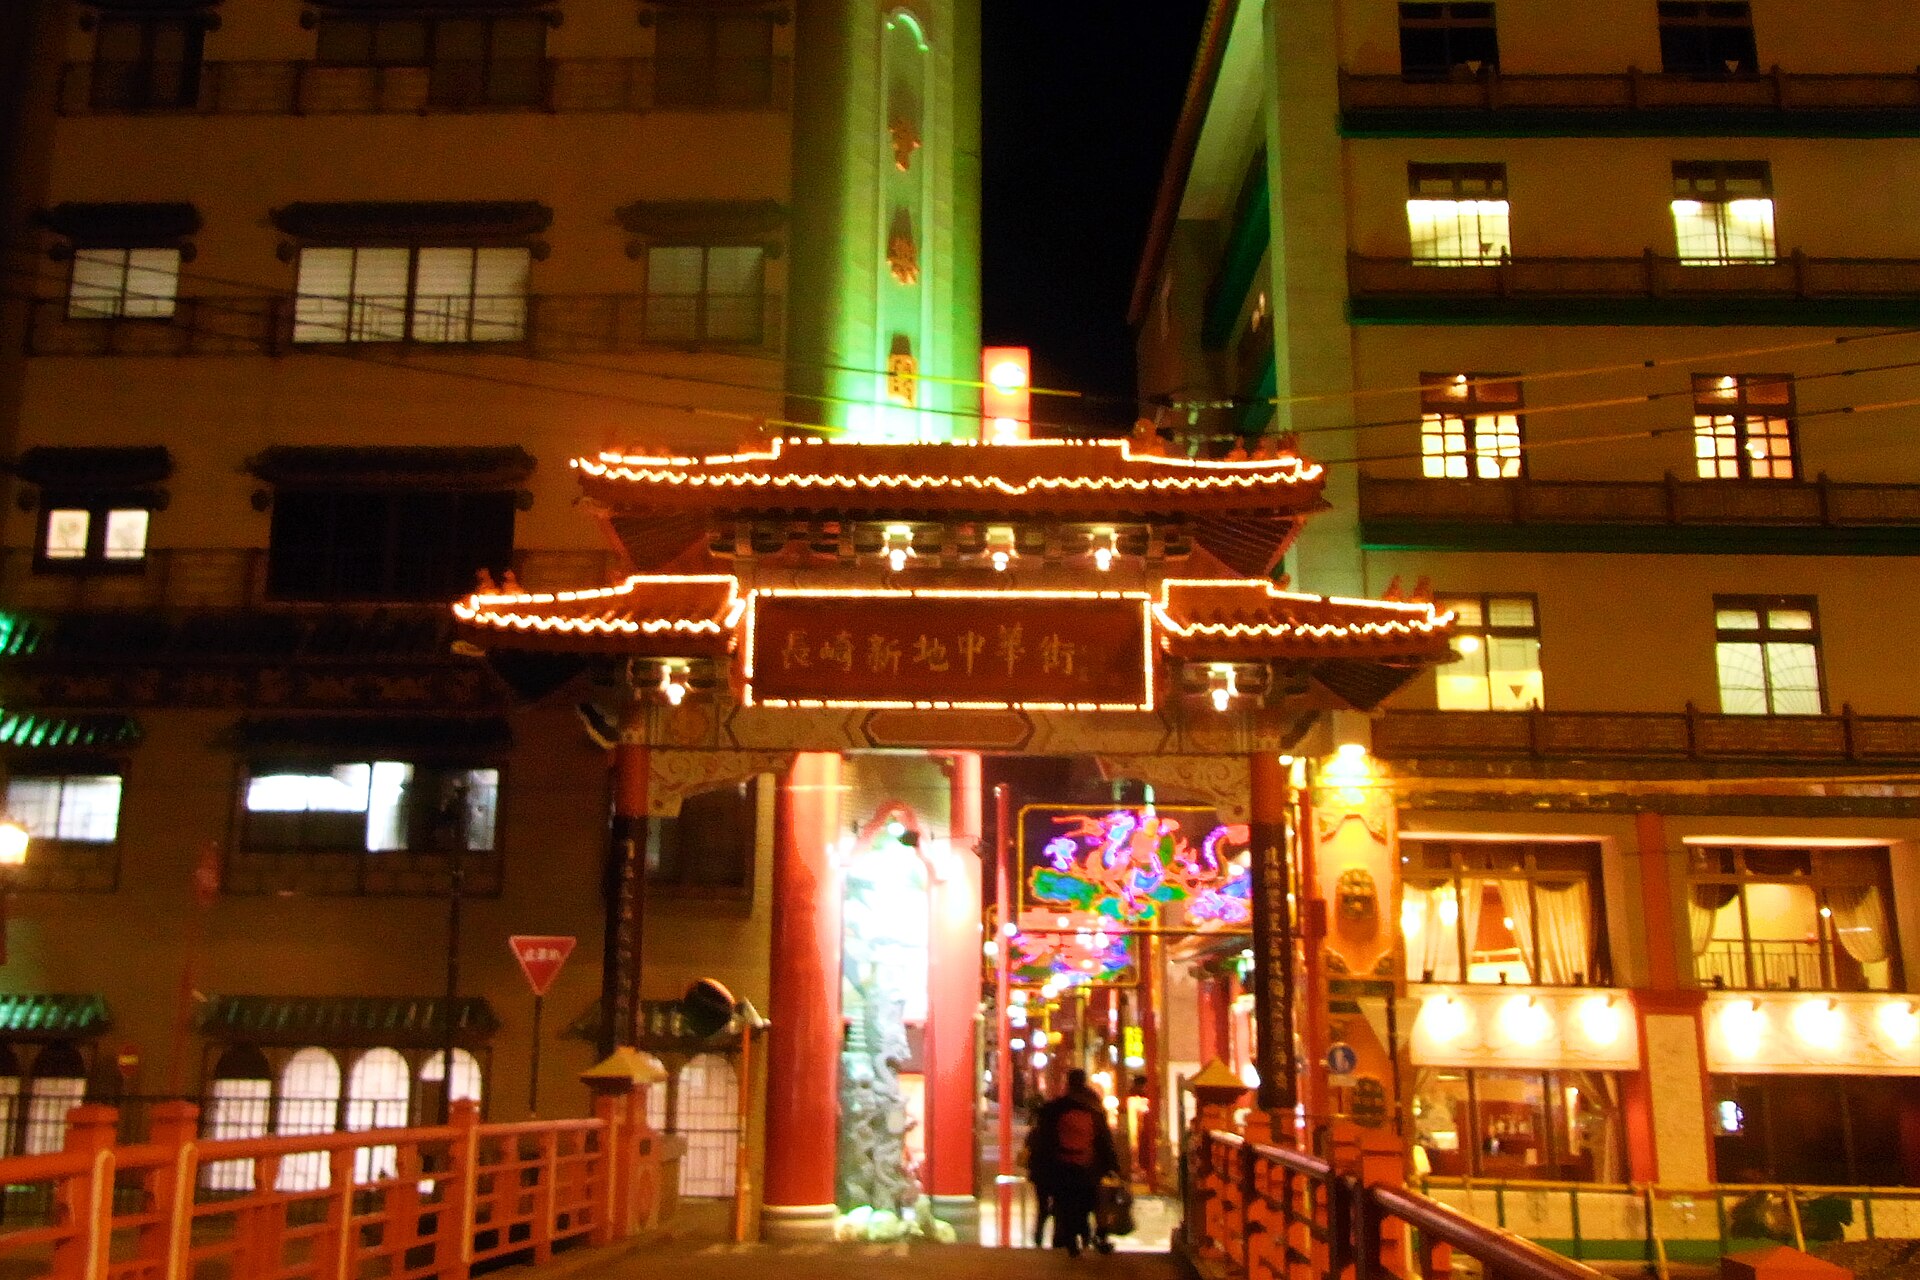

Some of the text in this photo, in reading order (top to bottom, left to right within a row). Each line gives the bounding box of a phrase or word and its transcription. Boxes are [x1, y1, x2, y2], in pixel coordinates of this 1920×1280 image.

[780, 621, 1075, 679] 長崎新地中華街
